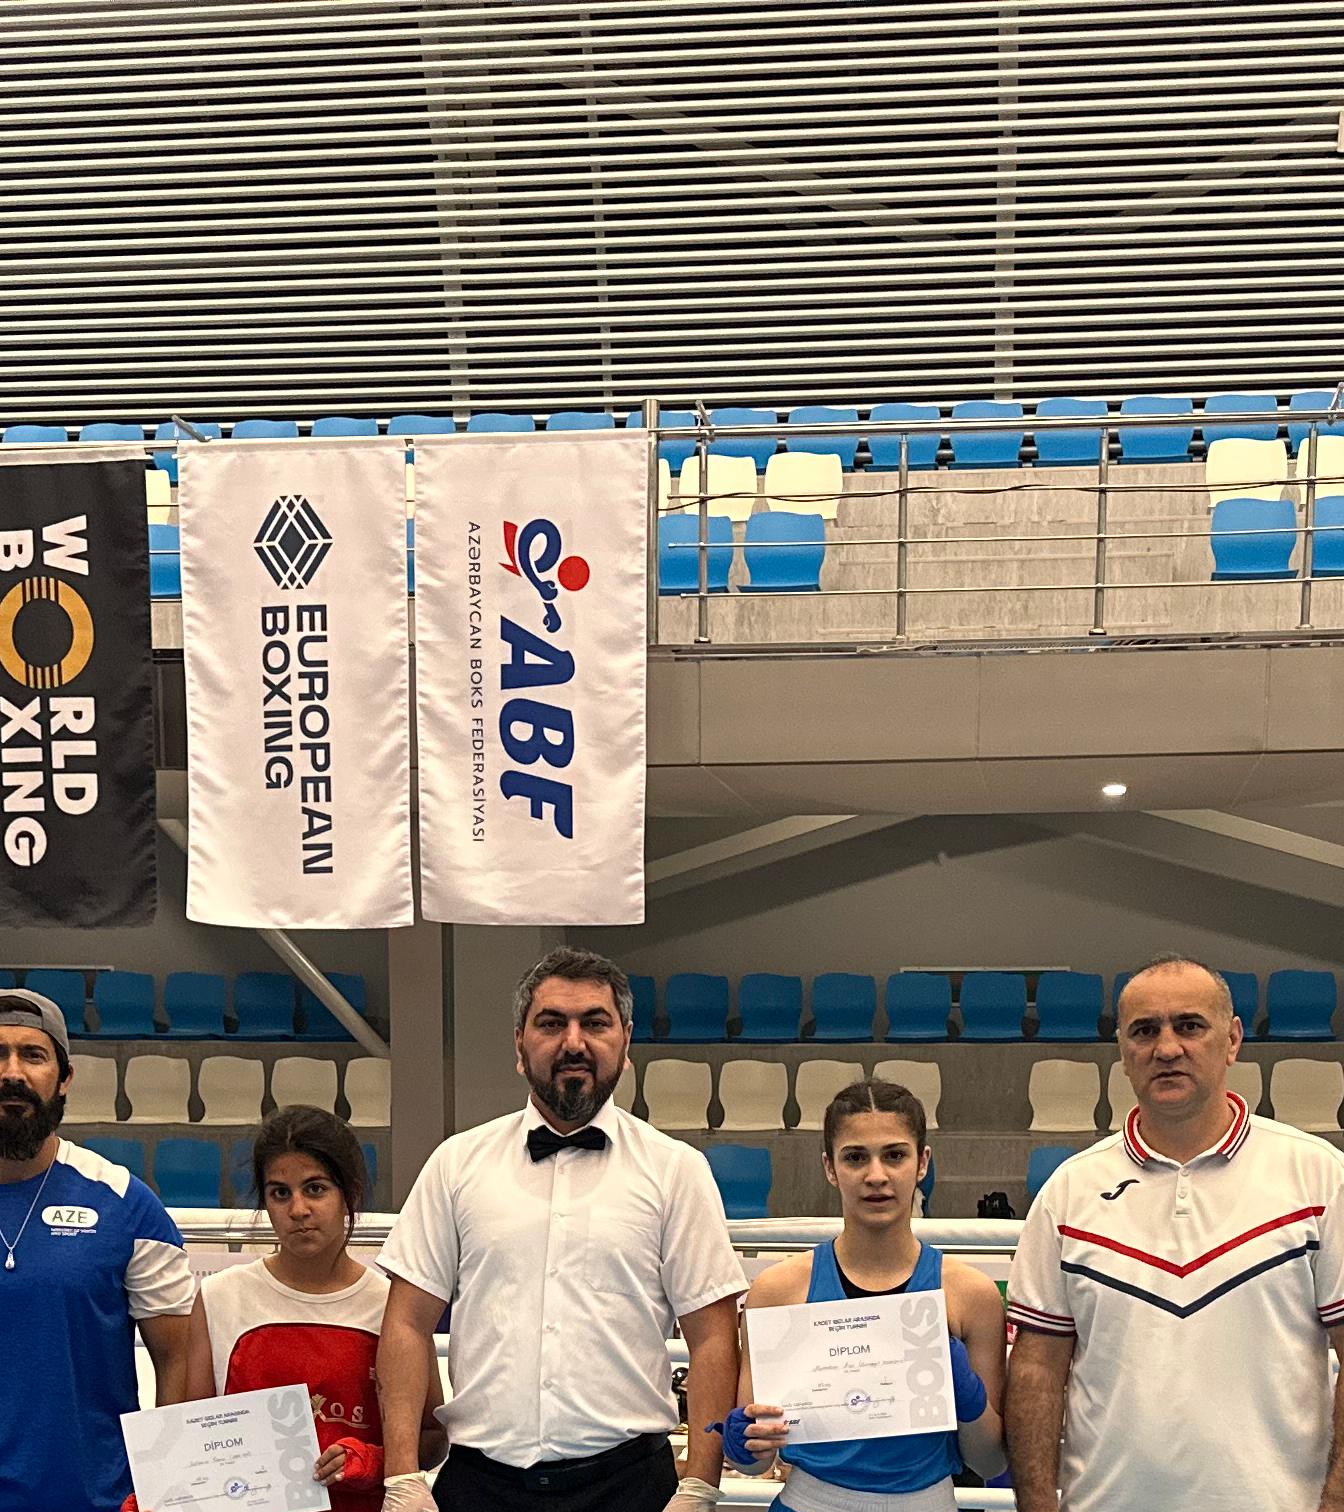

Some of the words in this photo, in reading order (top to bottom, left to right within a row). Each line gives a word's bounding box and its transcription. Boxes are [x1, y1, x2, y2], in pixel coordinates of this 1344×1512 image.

[468, 521, 483, 650] AZƏRBAYCAN
[32, 514, 99, 816] WORLD
[261, 606, 294, 790] BOXING
[470, 659, 483, 709] BOKS
[498, 614, 576, 840] ABF
[296, 604, 334, 874] EUROPEAN
[472, 718, 487, 842] FEDERASİYASI
[51, 1209, 88, 1224] AZE
[829, 1344, 871, 1357] DİPLOM
[900, 1295, 949, 1429] BOKS
[203, 1437, 244, 1452] DİPLOM
[266, 1390, 323, 1511] BOKS
